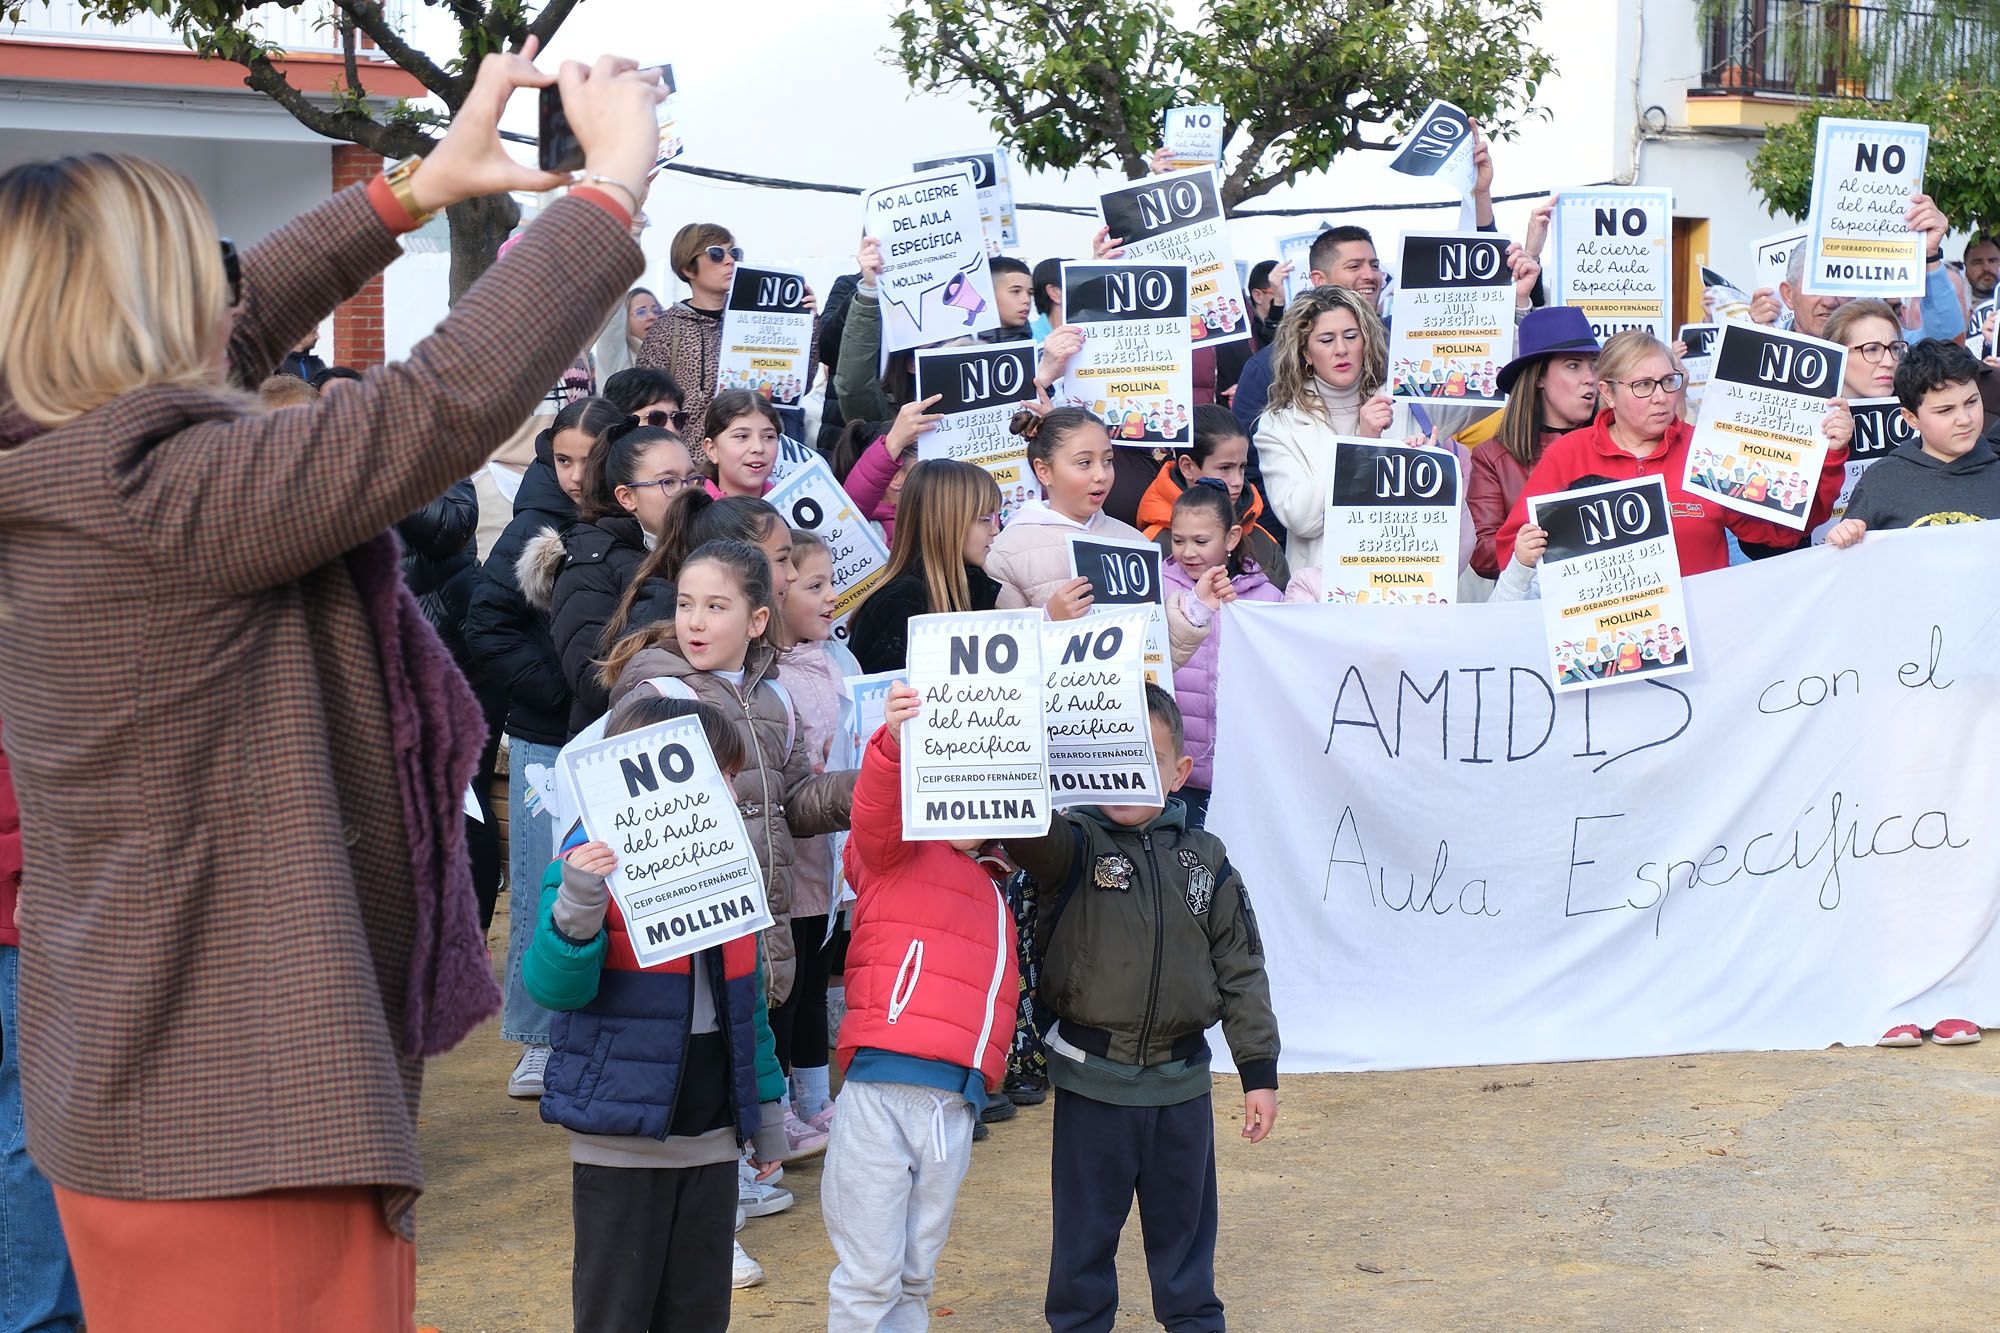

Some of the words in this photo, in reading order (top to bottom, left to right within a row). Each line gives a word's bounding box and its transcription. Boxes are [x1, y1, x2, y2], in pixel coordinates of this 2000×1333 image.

[1184, 115, 1211, 128] NO
[1413, 116, 1465, 159] NO
[1855, 143, 1906, 175] NO
[877, 197, 894, 212] NO
[898, 194, 913, 207] AL
[914, 184, 959, 203] CIERRE
[1839, 178, 1859, 192] Al
[1862, 181, 1911, 196] cierre
[1137, 180, 1203, 230] NO
[1837, 197, 1863, 212] del
[1867, 200, 1907, 215] Aula
[892, 217, 917, 232] DEL
[920, 210, 952, 227] AULA
[1595, 208, 1648, 237] NO
[1831, 217, 1911, 236] Específica
[891, 231, 962, 256] ESPECÍFICA
[1128, 247, 1144, 259] AL
[1146, 231, 1190, 253] CIERRE
[1193, 223, 1217, 244] DEL
[1577, 241, 1598, 255] Al
[1600, 244, 1650, 256] cierre
[1439, 242, 1501, 281] NO
[1577, 259, 1604, 273] del
[1608, 260, 1650, 274] Aula
[1770, 252, 1786, 266] NO
[892, 272, 934, 288] MOLLINA
[1826, 264, 1909, 280] MOLLINA
[757, 277, 805, 308] NO
[1105, 270, 1174, 313] NO
[1413, 293, 1429, 305] AL
[1434, 291, 1478, 303] CIERRE
[1482, 290, 1505, 302] DEL
[1572, 279, 1657, 295] Específica
[1423, 313, 1497, 328] ESPECÍFICA
[1443, 304, 1475, 315] AULA
[752, 316, 785, 326] CIERRE
[787, 317, 806, 327] DEL
[1082, 328, 1098, 339] AL
[1103, 324, 1150, 338] CIERRE
[1155, 322, 1182, 336] DEL
[1114, 338, 1149, 351] AULA
[1436, 345, 1483, 354] MOLLINA
[752, 359, 788, 367] MOLLINA
[1093, 348, 1173, 365] ESPECÍFICA
[1759, 342, 1829, 390] NO
[959, 354, 1025, 403] NO
[1078, 368, 1094, 376] CEIP
[1097, 366, 1131, 375] GERARDO
[1110, 383, 1161, 393] MOLLINA
[1727, 386, 1744, 399] AL
[1748, 390, 1798, 409] CIERRE
[1802, 399, 1828, 414] DEL
[936, 418, 952, 433] AL
[956, 410, 1003, 430] CIERRE
[1757, 404, 1793, 420] AULA
[968, 423, 1000, 441] AULA
[1716, 422, 1733, 431] CEIP
[1734, 425, 1770, 438] GERARDO
[1733, 411, 1814, 437] ESPECÍFICA
[948, 433, 1024, 458] ESPECÍFICA
[1743, 443, 1793, 462] MOLLINA
[1376, 455, 1443, 498] NO
[1347, 511, 1364, 523] AL
[1370, 511, 1418, 523] CIERRE
[1422, 511, 1448, 523] DEL
[1579, 492, 1652, 546] NO
[1380, 525, 1415, 538] AULA
[1358, 537, 1439, 552] ESPECÍFICA
[1561, 562, 1580, 578] AL
[1584, 550, 1635, 572] CIERRE
[1639, 543, 1665, 560] DEL
[1100, 553, 1150, 596] NO
[1374, 574, 1425, 583] MOLLINA
[1599, 564, 1635, 583] AULA
[1577, 571, 1662, 602] ESPECÍFICA
[1564, 607, 1581, 616] CEIP
[1582, 598, 1620, 612] GERARDO
[1621, 587, 1665, 603] FERNÁNDEZ
[1599, 608, 1652, 628] MOLLINA
[950, 633, 1019, 676] NO
[1060, 626, 1124, 666] NO
[1046, 671, 1058, 689] l
[1060, 671, 1121, 688] cierre
[926, 683, 953, 703] Al
[956, 685, 1022, 703] cierre
[1068, 691, 1122, 712] Aula
[1324, 664, 1692, 774] AMIDIS
[1758, 668, 1860, 714] con
[1898, 624, 1956, 690] el
[928, 707, 962, 729] del
[966, 707, 1021, 729] Aula
[1047, 718, 1135, 742] pecífica
[924, 735, 1031, 761] Específica
[1050, 751, 1091, 760] GERARDO
[1092, 748, 1145, 759] FERNÁNDEZ
[619, 742, 695, 799] NO
[922, 774, 943, 784] CEIP
[944, 772, 986, 783] GERARDO
[987, 768, 1038, 782] FERNÁNDEZ
[615, 806, 641, 831] Al
[644, 791, 711, 824] cierre
[926, 799, 1037, 821] MOLLINA
[623, 828, 659, 854] del
[663, 813, 718, 845] Aula
[624, 839, 735, 882] Específica
[1323, 804, 1502, 917] Aula
[1565, 792, 1970, 940] Específica
[633, 897, 655, 911] CEIP
[655, 883, 699, 906] GERARDO
[699, 866, 750, 890] FERNÁNDEZ
[646, 895, 756, 947] MOLLINA
